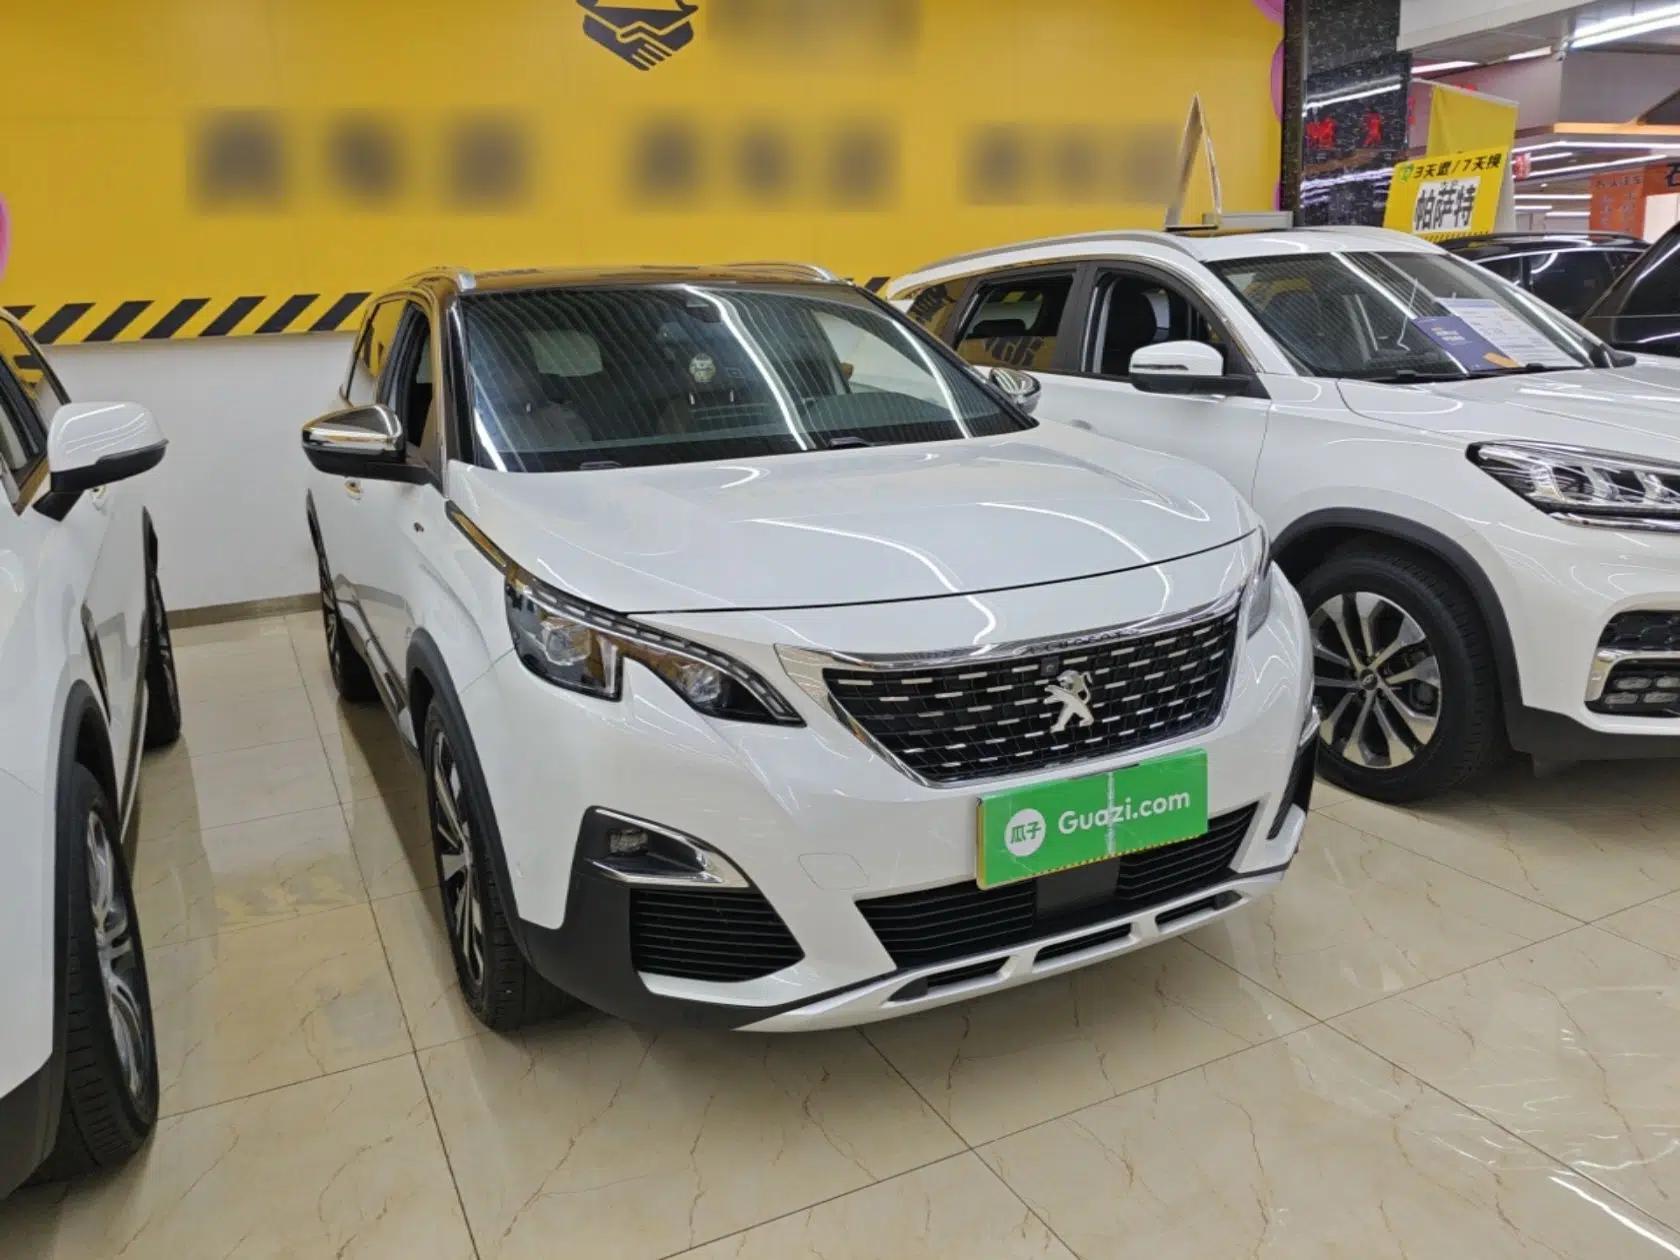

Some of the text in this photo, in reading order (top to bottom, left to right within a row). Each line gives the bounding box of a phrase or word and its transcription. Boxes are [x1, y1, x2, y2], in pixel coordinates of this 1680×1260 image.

[1415, 184, 1476, 230] 帕萨特
[1010, 821, 1042, 844] 瓜子
[1058, 791, 1190, 834] Guazi.com
